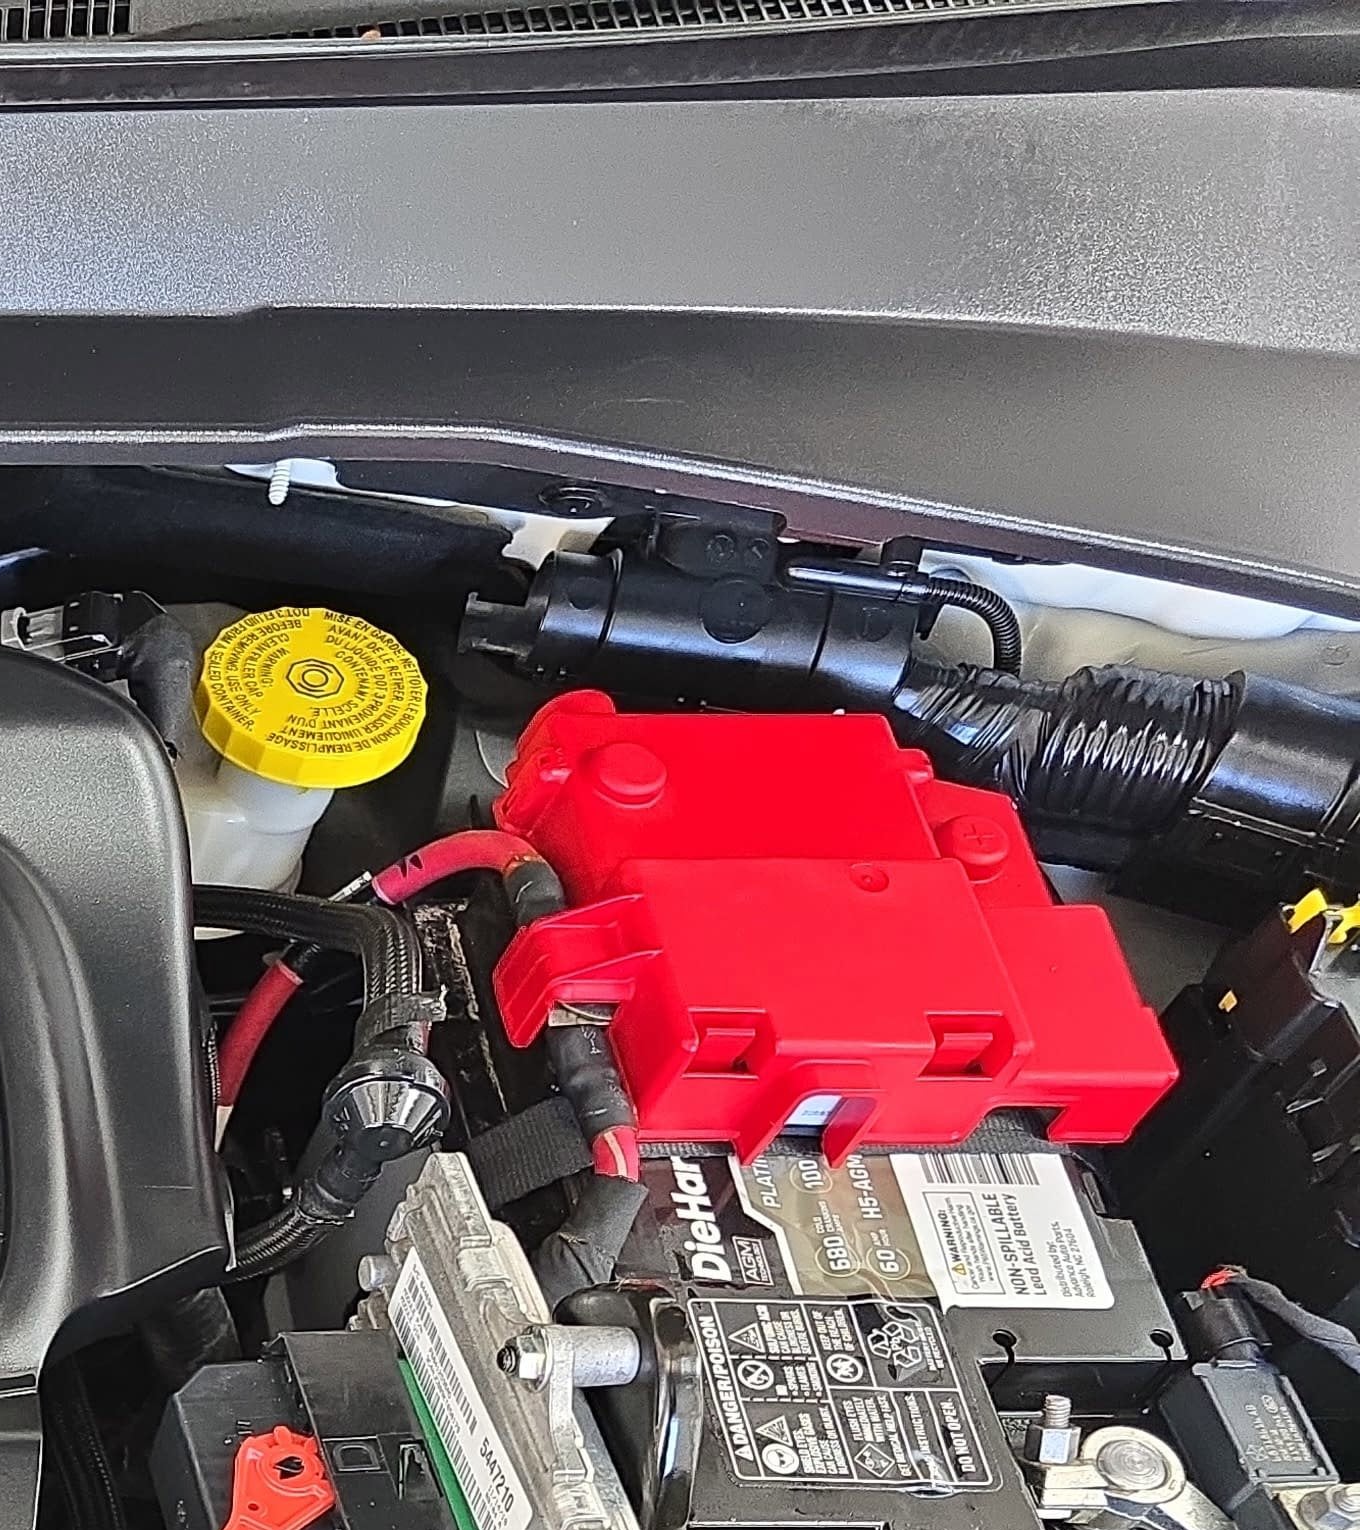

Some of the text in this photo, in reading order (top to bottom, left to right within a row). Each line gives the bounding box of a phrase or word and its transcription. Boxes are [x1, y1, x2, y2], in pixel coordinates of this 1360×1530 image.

[287, 608, 310, 617] DOT
[323, 611, 352, 625] MISE
[257, 620, 301, 637] BEFORE
[328, 625, 366, 644] AVANT
[354, 619, 371, 632] EN
[253, 633, 290, 653] CLEAN
[325, 635, 343, 646] DU
[366, 641, 384, 655] DE
[208, 650, 224, 681] SEALED
[382, 653, 393, 664] LE
[226, 675, 242, 692] USE
[244, 681, 264, 697] CAP
[334, 651, 371, 702] CONTENANT
[374, 674, 388, 692] DOT
[402, 657, 423, 703] NETTOYER
[235, 692, 261, 715] ONLY
[322, 700, 383, 730] PROVENANT
[407, 703, 419, 714] LE
[363, 704, 401, 734] UTILISER
[372, 712, 415, 744] BOUCHON
[266, 733, 352, 753] REMPLISSAGE
[280, 725, 362, 741] UNIQUEMENT
[356, 740, 372, 751] DE
[847, 1154, 884, 1219] H5-AGM
[670, 1155, 733, 1282] DieHar
[813, 1217, 825, 1234] COLD
[818, 1201, 835, 1233] CRANKING
[870, 1232, 882, 1246] AMP
[938, 1210, 962, 1263] WARNING:
[950, 1215, 969, 1253] Reproductive
[966, 1231, 977, 1245] after
[981, 1192, 1030, 1296] NON-SPILLABLE
[1002, 1192, 1048, 1296] Lead Acid Battery
[1064, 1228, 1080, 1253] 27604
[737, 1241, 761, 1282] AGM
[750, 1242, 770, 1282] TECHNOLOGY
[823, 1235, 851, 1272] 680
[875, 1249, 900, 1274] 60
[963, 1254, 974, 1267] and
[972, 1246, 982, 1264] hands
[1058, 1244, 1072, 1263] Auto
[1072, 1254, 1083, 1267] NC
[967, 1267, 980, 1289] Cancer
[977, 1265, 987, 1283] Wash
[1046, 1241, 1073, 1297] Distributed by:
[1065, 1264, 1085, 1297] Advance
[756, 1305, 771, 1321] ACID
[774, 1321, 791, 1354] CAN CAUSE
[780, 1311, 802, 1354] BLINDNESS OR
[812, 1310, 833, 1350] KEEP OUT OF
[825, 1316, 843, 1351] THE REACH
[797, 1332, 811, 1355] SEVERE
[843, 1341, 855, 1351] OF
[888, 1337, 902, 1351] Pb
[698, 1315, 749, 1445] DANGER/POISON
[783, 1365, 798, 1391] SPARKS
[795, 1365, 810, 1391] FLAMES
[806, 1361, 822, 1392] SMOKING
[842, 1400, 863, 1441] FLUSH EYES
[852, 1396, 874, 1442] IMMEDIATELY
[883, 1413, 897, 1432] HELP
[798, 1413, 826, 1474] EXPLOSIVE GASES
[826, 1429, 838, 1440] OR
[873, 1424, 885, 1442] WITH
[940, 1399, 976, 1473] DO NOT OPEN.
[818, 1439, 838, 1475] CAN CAUSE
[889, 1433, 907, 1463] MEDICAL
[798, 1448, 815, 1474] SHIELD
[899, 1464, 912, 1477] GET
[479, 1437, 515, 1513] 5447210
